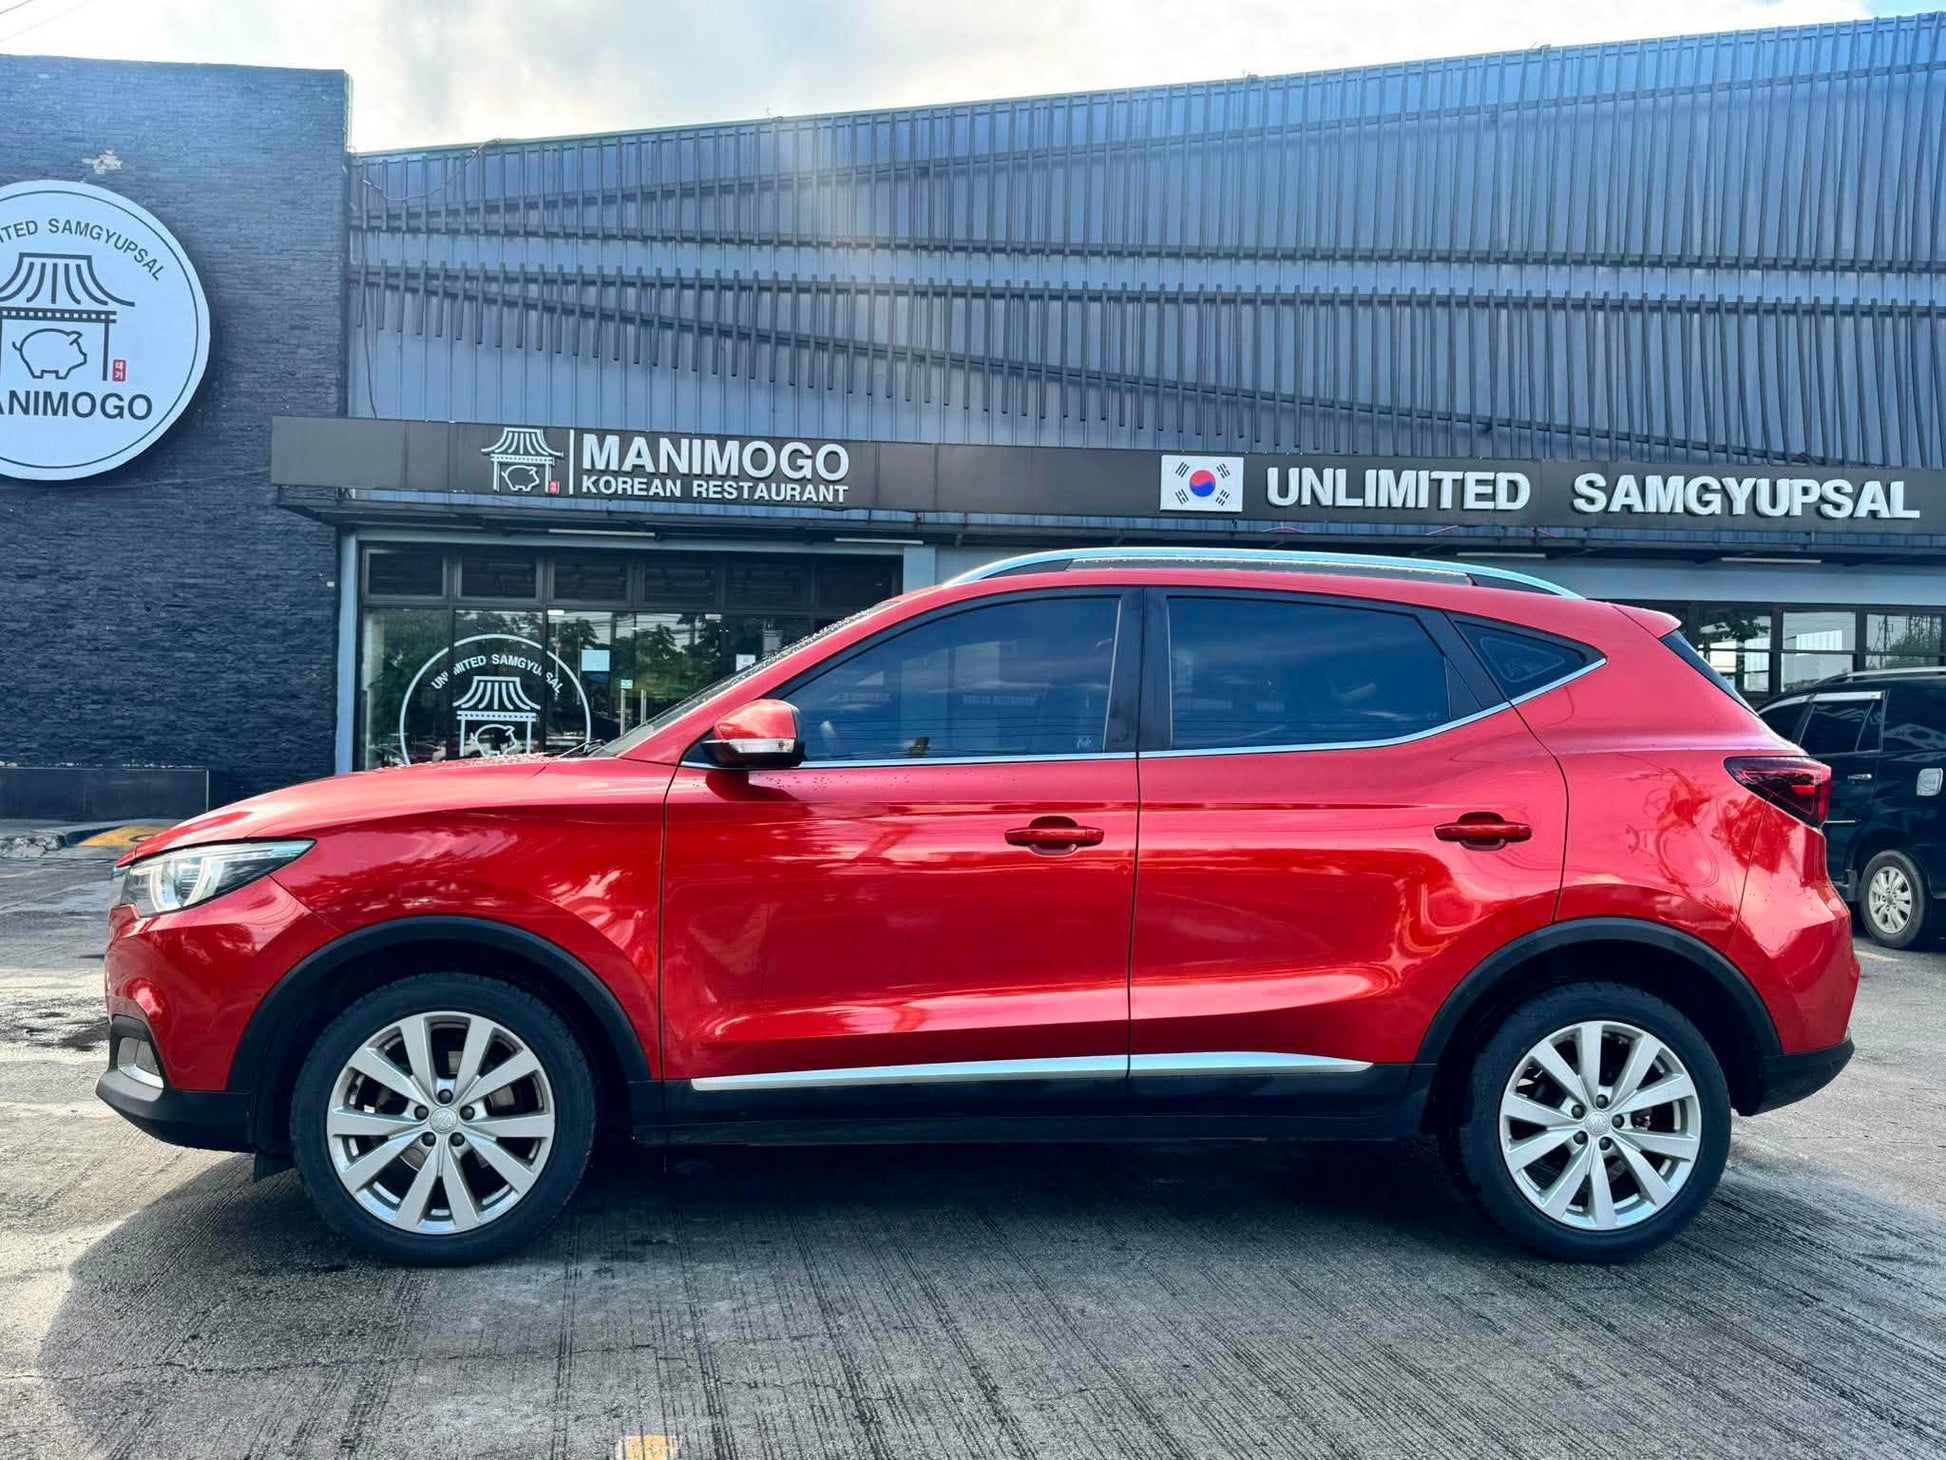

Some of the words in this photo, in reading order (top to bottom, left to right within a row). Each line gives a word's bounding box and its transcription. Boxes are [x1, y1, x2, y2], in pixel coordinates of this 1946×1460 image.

[48, 218, 164, 281] SAMGYUPSAL
[0, 390, 153, 421] NIMOGO
[582, 433, 850, 482] MANIMOGO
[582, 475, 681, 498] KOREAN
[692, 480, 849, 503] RESTAURANT
[1266, 467, 1532, 511] UNLIMITED
[1572, 472, 1921, 519] SAMGYUPSAL
[491, 654, 563, 694] SAMGYUSAL
